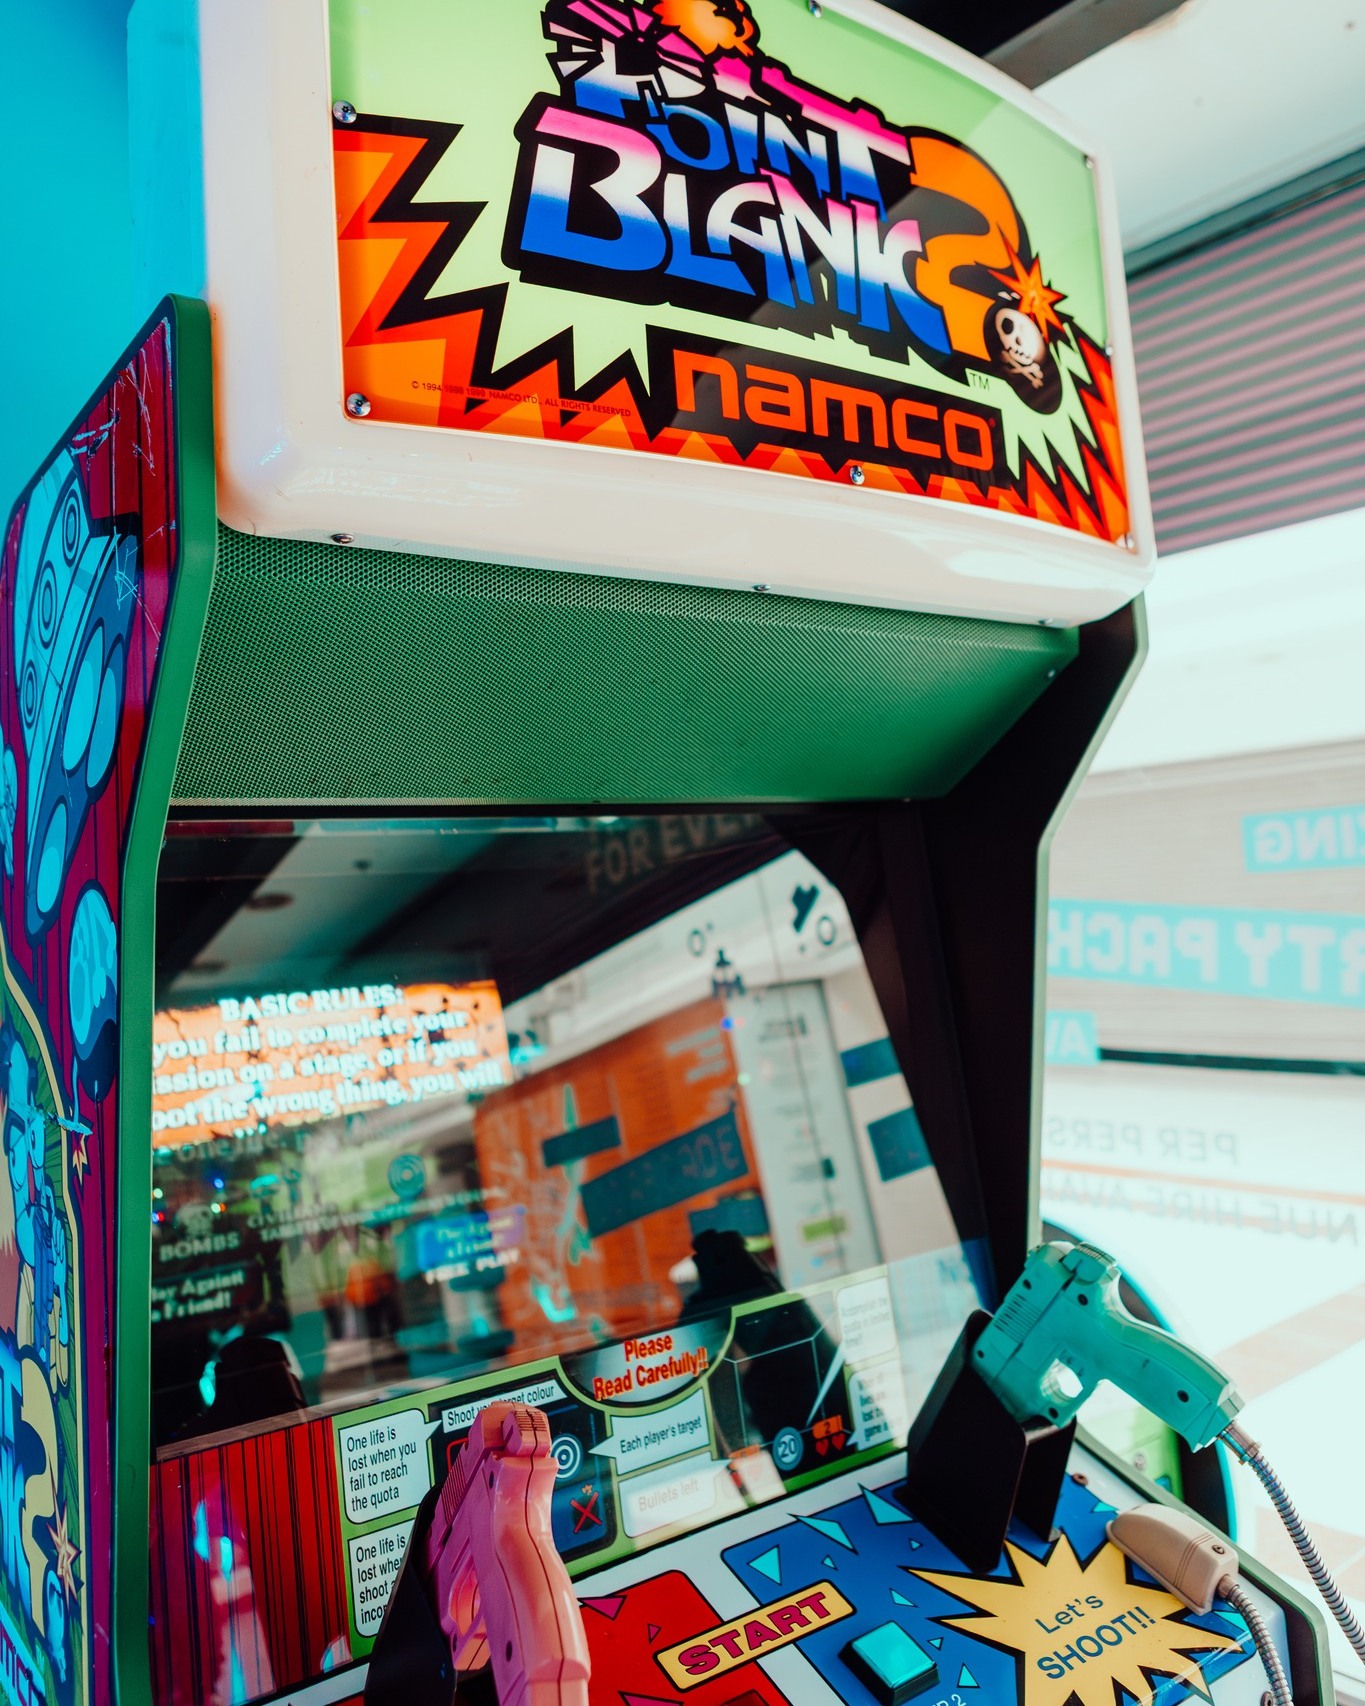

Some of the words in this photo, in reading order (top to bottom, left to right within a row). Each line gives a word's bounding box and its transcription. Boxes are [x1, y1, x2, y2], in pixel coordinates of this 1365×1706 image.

[574, 37, 911, 222] POINT
[521, 106, 951, 354] BLANK
[910, 136, 1019, 361] 2
[969, 372, 990, 391] TM
[422, 383, 442, 391] 1994
[489, 391, 521, 402] NAMCO
[545, 398, 559, 408] ALL
[561, 401, 590, 411] RIGHTS
[593, 404, 631, 417] RESERVED
[674, 349, 994, 471] namco
[218, 990, 309, 1022] BASIC
[311, 983, 404, 1012] RULES:
[153, 1037, 209, 1069] you
[214, 1024, 262, 1054] fail
[267, 1025, 294, 1049] to
[297, 1014, 407, 1046] complete
[411, 1011, 469, 1039] your
[239, 1062, 275, 1084] on
[279, 1060, 296, 1080] a
[377, 1048, 405, 1067] or
[407, 1037, 427, 1063] if
[430, 1039, 478, 1067] you
[201, 1095, 249, 1123] the
[252, 1088, 336, 1119] wrong
[409, 1073, 456, 1101] you
[458, 1059, 504, 1090] will
[160, 1231, 240, 1261] BOMBS
[624, 1335, 673, 1362] Please
[592, 1368, 634, 1401] Read
[635, 1346, 709, 1387] Carefully!!
[447, 1406, 476, 1426] Shoot
[527, 1385, 554, 1404] colour
[347, 1436, 367, 1452] One
[370, 1429, 385, 1446] life
[387, 1426, 396, 1441] is
[620, 1435, 641, 1454] Each
[644, 1425, 676, 1449] player's
[677, 1416, 702, 1434] target
[823, 1421, 831, 1436] 2
[348, 1454, 367, 1472] lost
[370, 1448, 396, 1466] when
[399, 1442, 416, 1461] you
[779, 1438, 798, 1459] 20
[350, 1473, 365, 1492] fail
[368, 1472, 378, 1487] to
[381, 1462, 408, 1483] reach
[352, 1495, 367, 1512] the
[371, 1486, 399, 1509] quota
[638, 1487, 678, 1512] Bullets
[681, 1478, 700, 1496] left
[356, 1546, 377, 1563] One
[379, 1537, 394, 1555] life
[397, 1533, 406, 1549] is
[357, 1564, 377, 1583] lost
[360, 1580, 388, 1604] shoot
[1035, 1595, 1104, 1634] Let's
[678, 1591, 831, 1676] START
[1037, 1606, 1156, 1680] SHOOT!!
